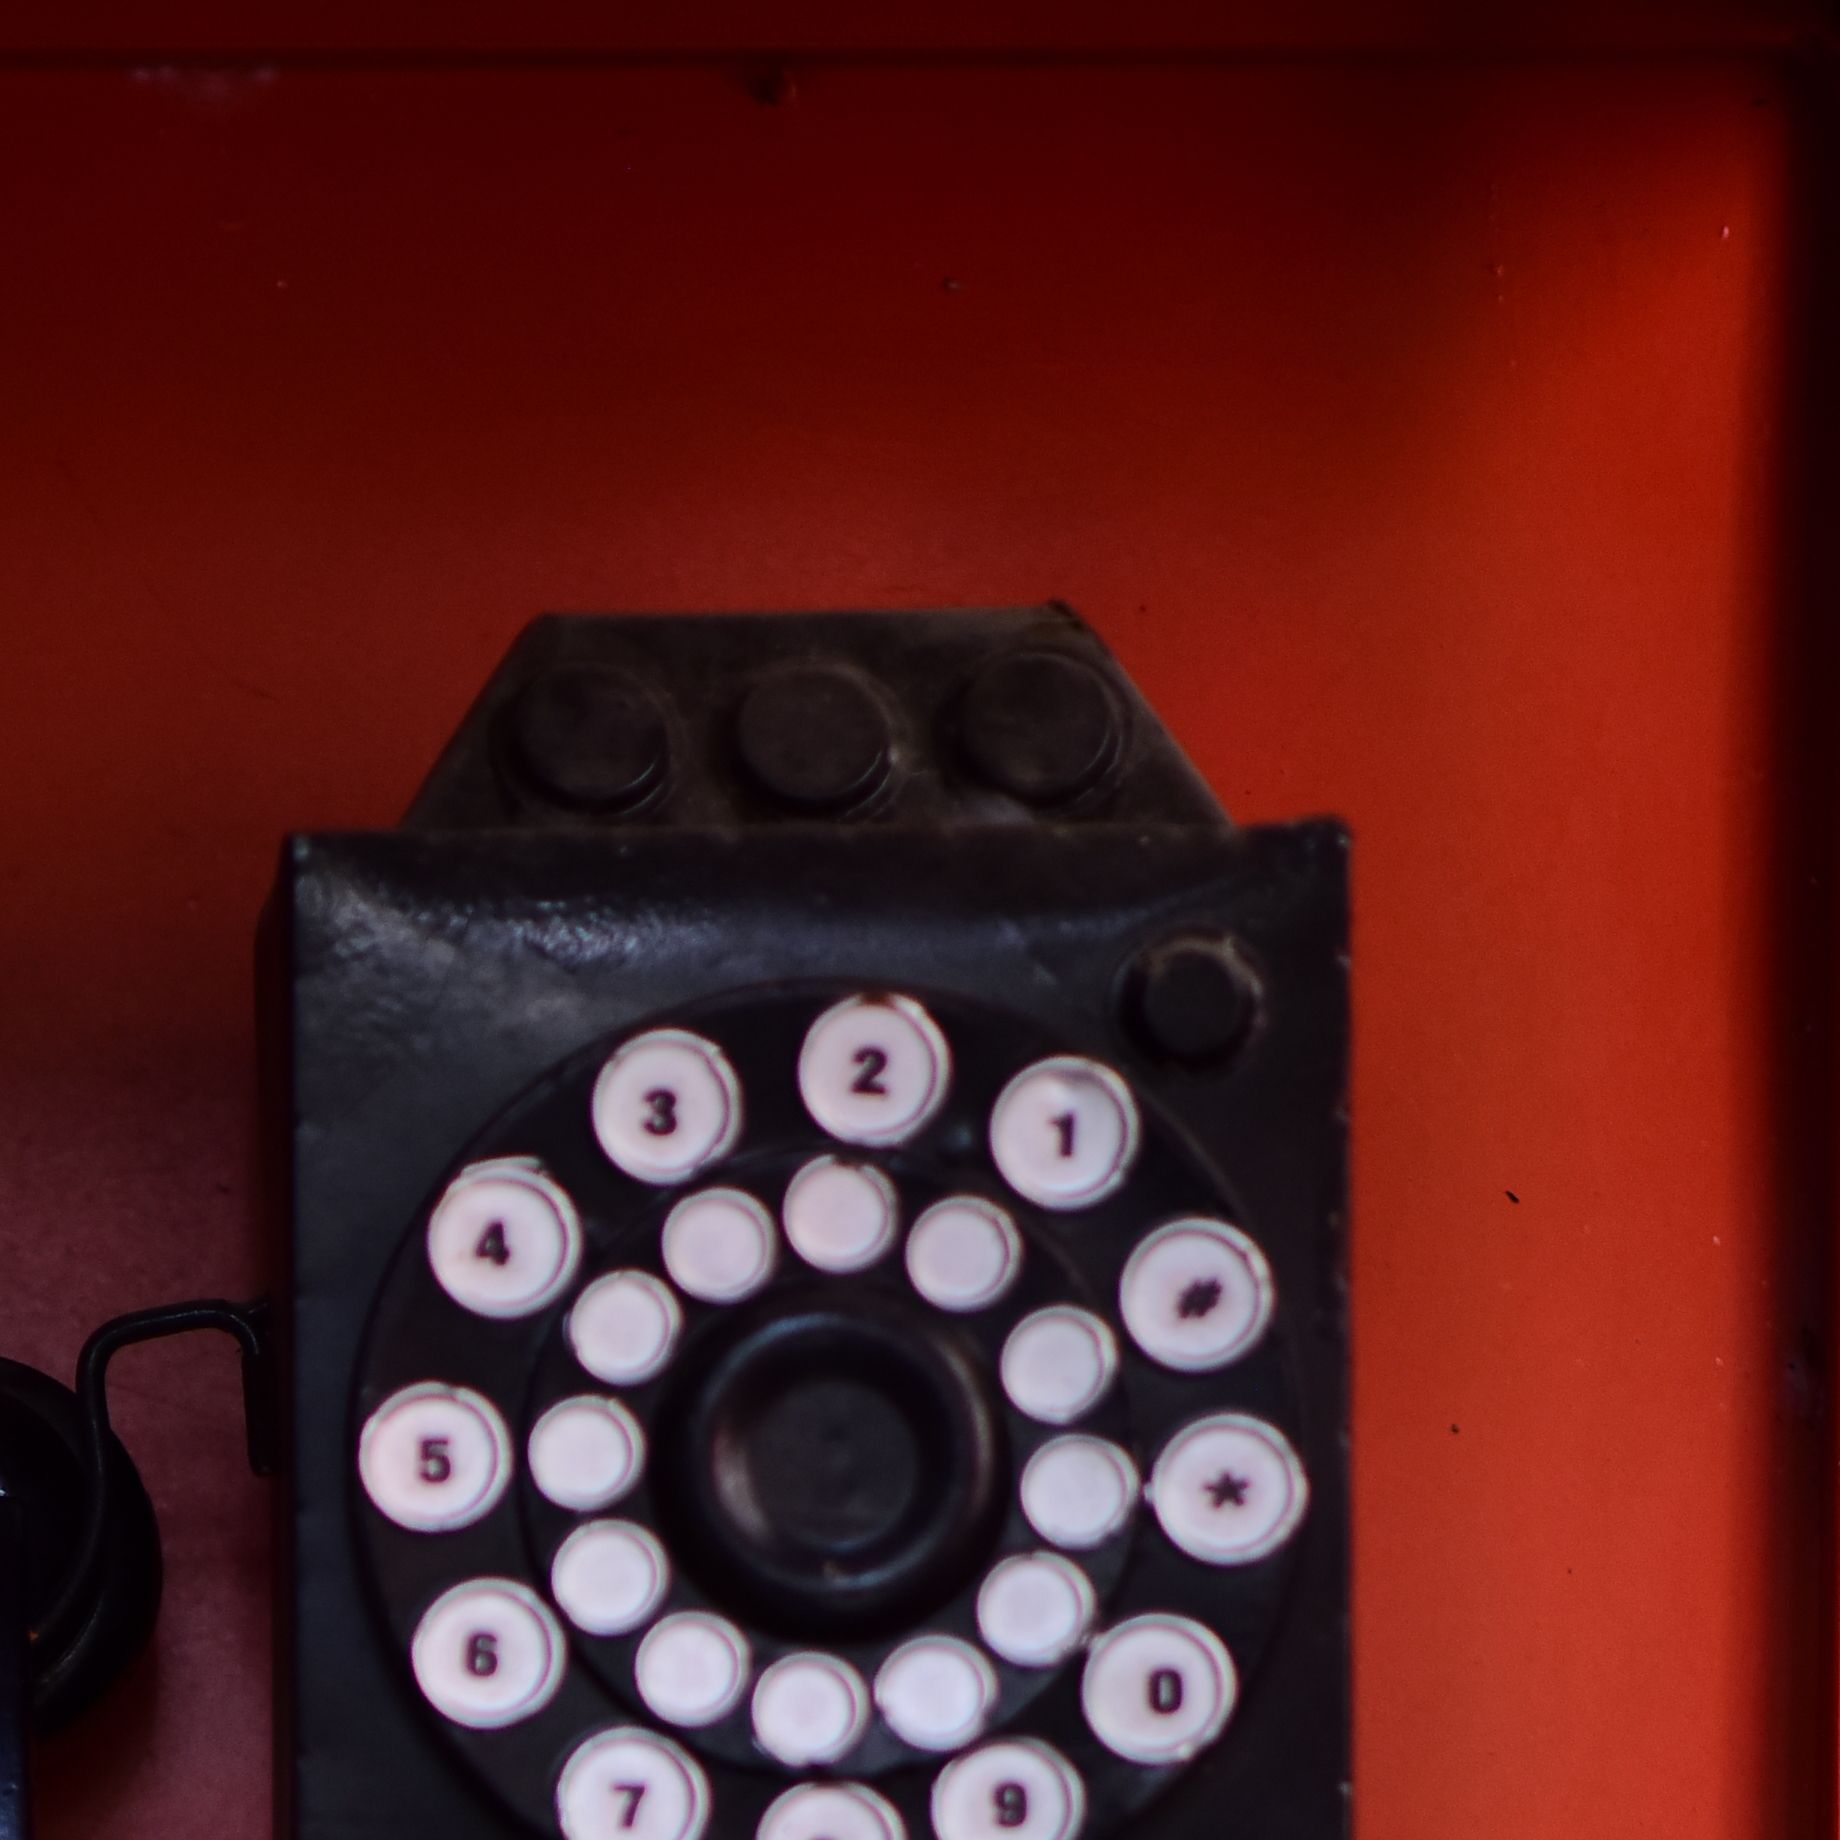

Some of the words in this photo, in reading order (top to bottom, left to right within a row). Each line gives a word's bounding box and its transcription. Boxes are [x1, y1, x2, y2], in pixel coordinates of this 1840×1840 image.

[850, 1045, 889, 1097] 2
[642, 1087, 679, 1138] 3
[1050, 1111, 1077, 1158] 1
[473, 1218, 512, 1268] 4
[417, 1435, 454, 1485] 5
[463, 1629, 500, 1679] 6
[1146, 1666, 1185, 1717] 0
[612, 1782, 648, 1830] 7
[991, 1780, 1030, 1829] 9
